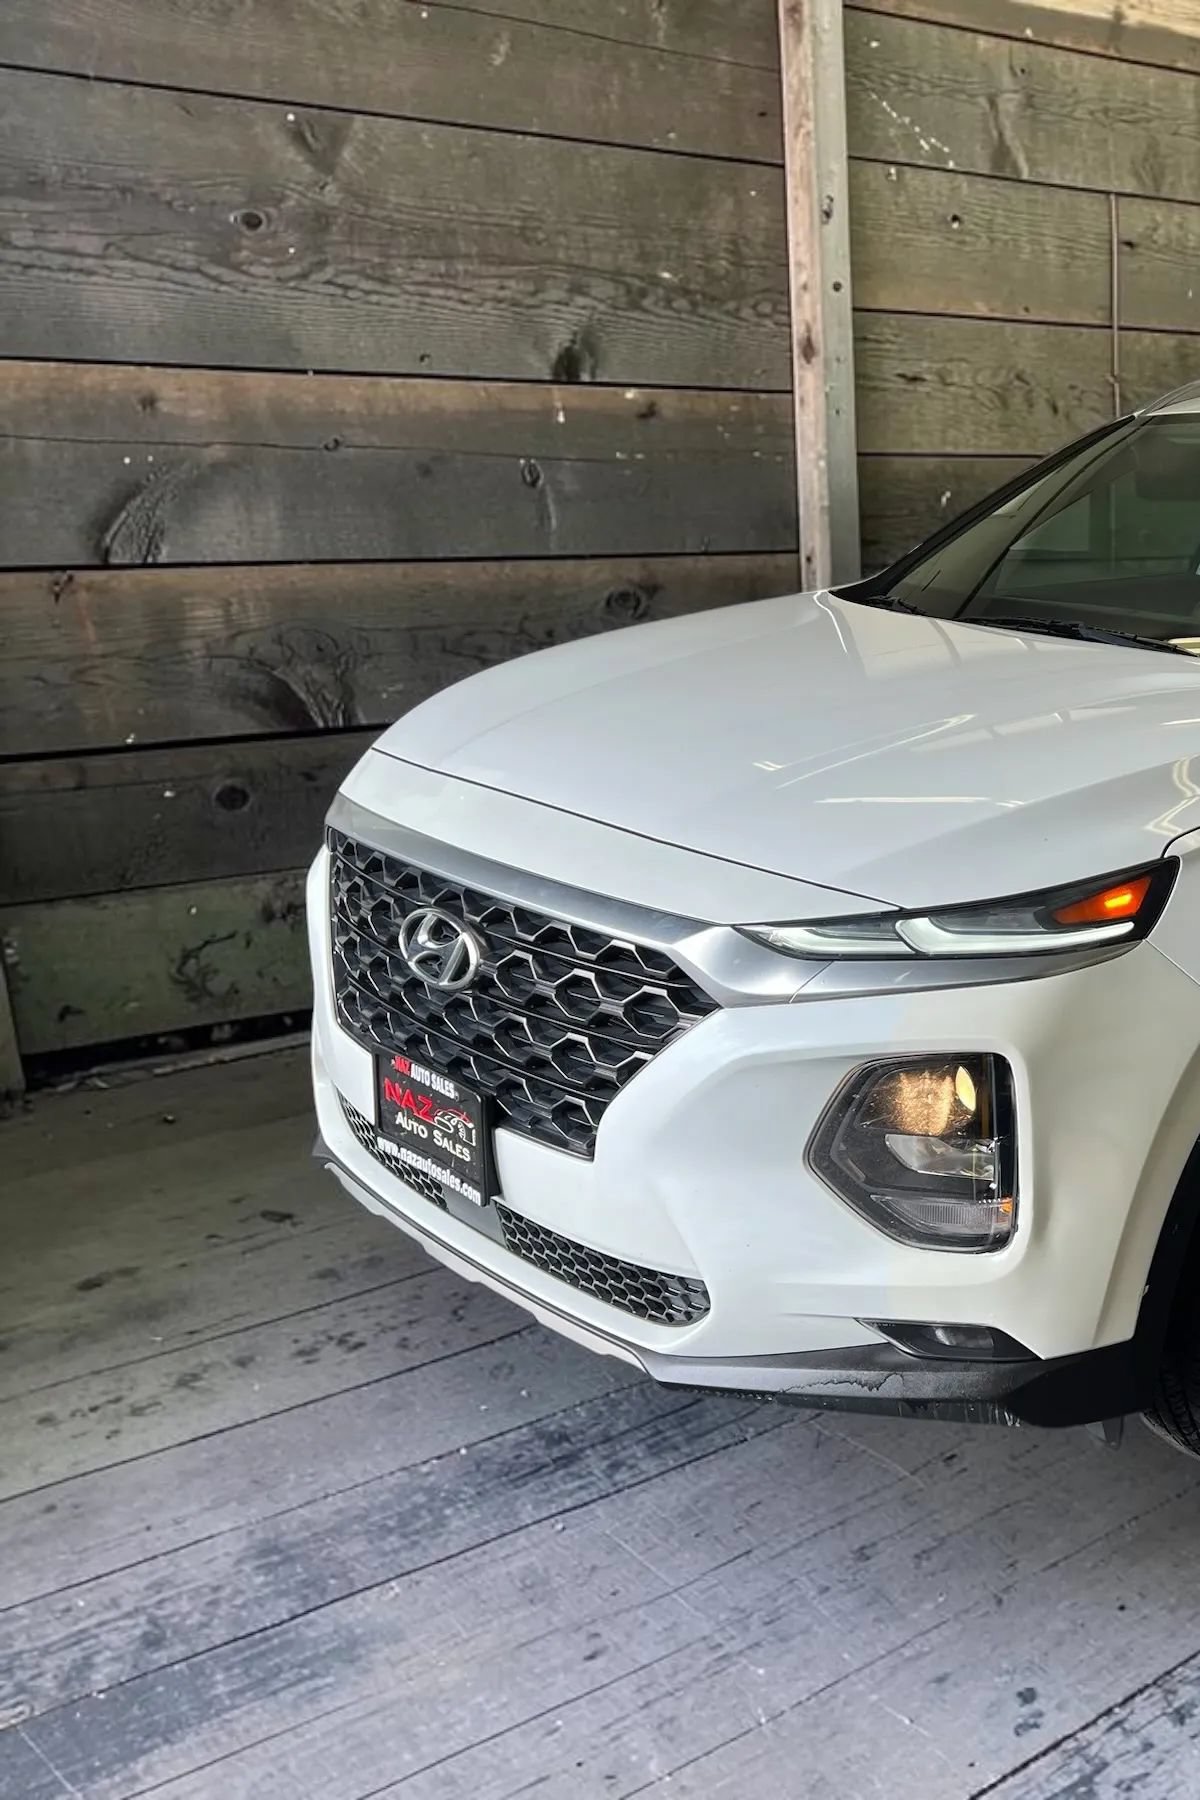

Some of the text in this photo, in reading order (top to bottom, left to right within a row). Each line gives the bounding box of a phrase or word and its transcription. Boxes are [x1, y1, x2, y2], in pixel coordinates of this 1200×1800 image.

[384, 1077, 434, 1122] NAZ
[411, 1063, 430, 1086] AUTO
[431, 1073, 455, 1099] SALES
[395, 1111, 471, 1162] AUTO SALES
[377, 1137, 481, 1205] www.nazautosales.com
